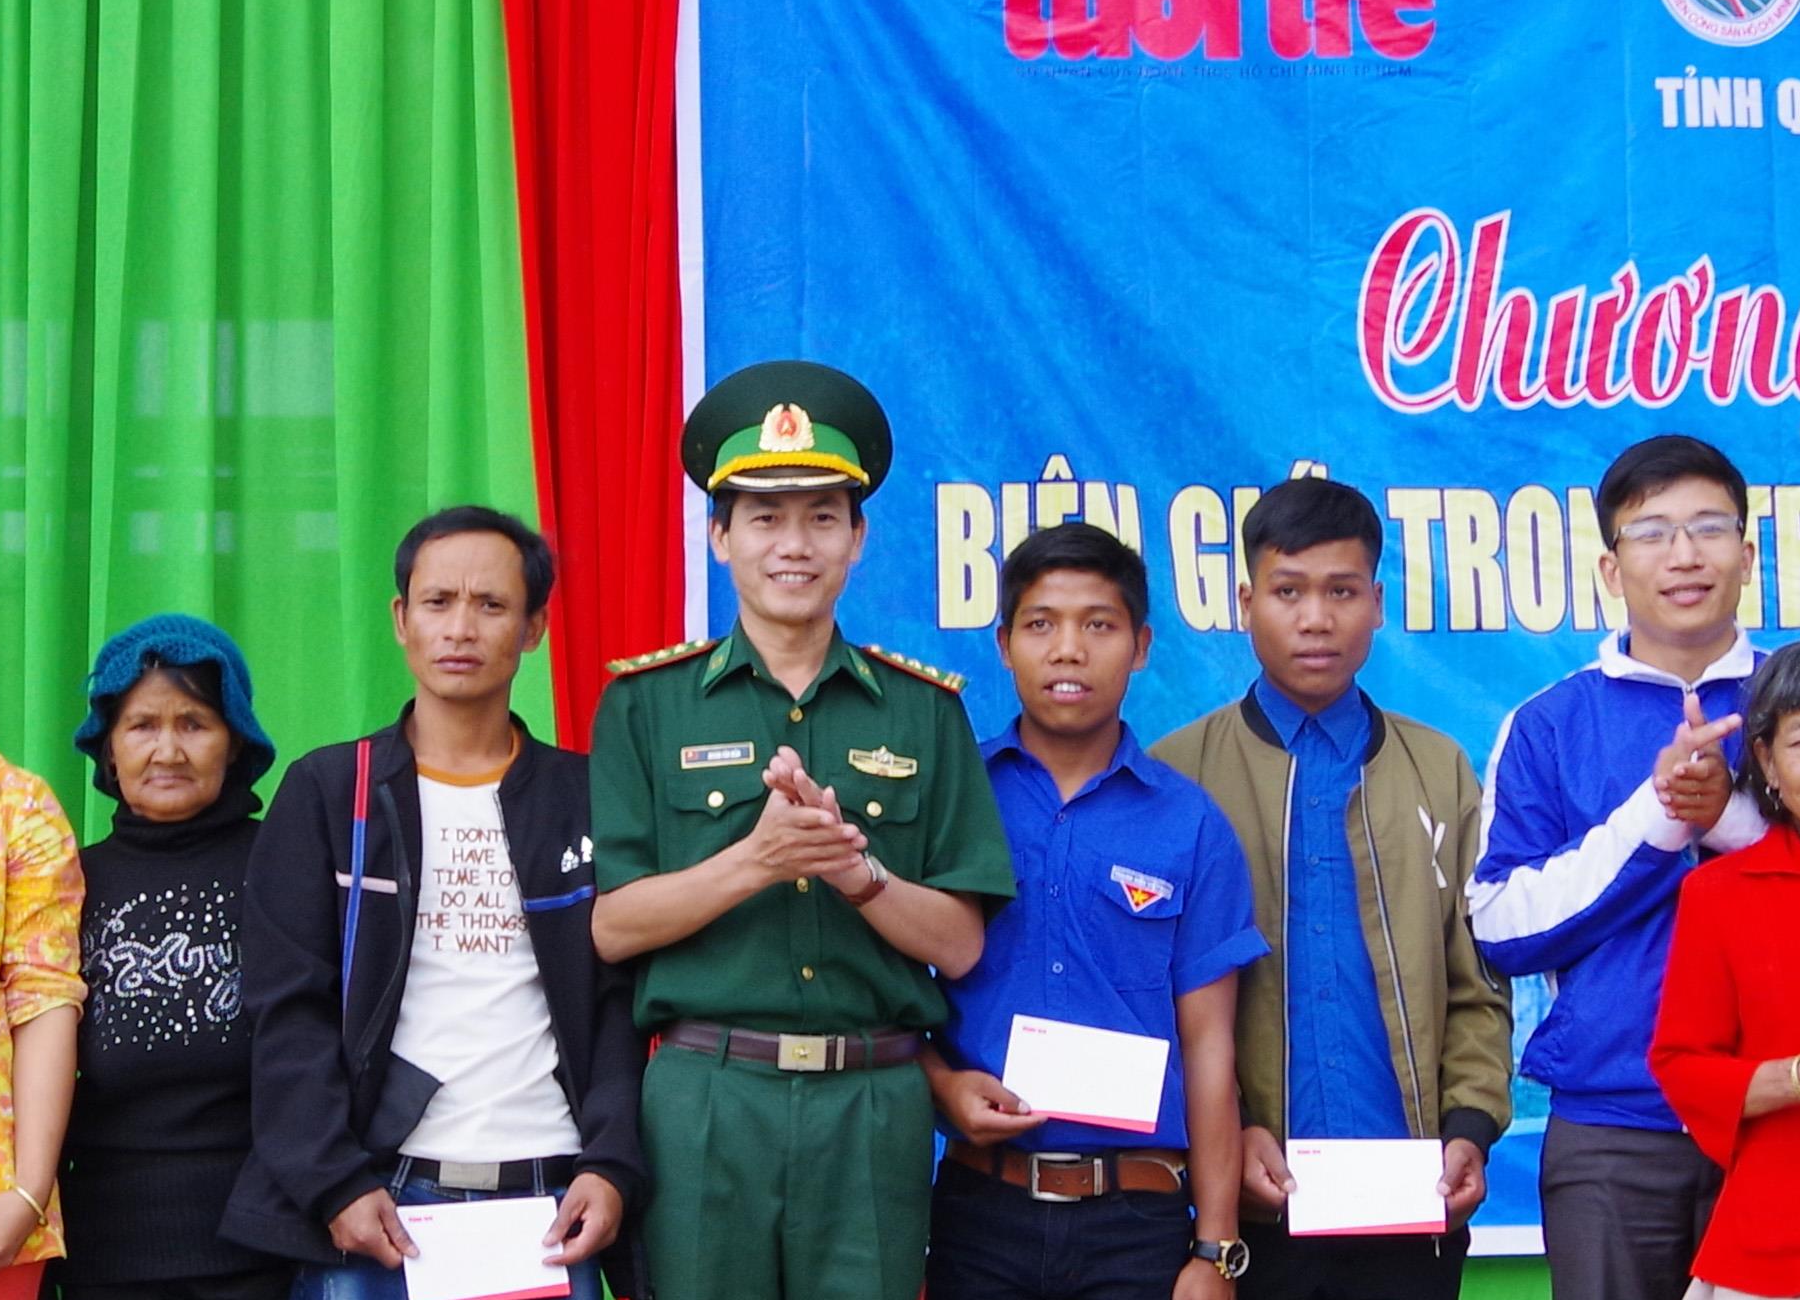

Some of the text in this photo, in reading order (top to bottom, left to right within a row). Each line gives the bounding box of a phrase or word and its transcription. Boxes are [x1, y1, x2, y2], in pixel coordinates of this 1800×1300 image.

[1655, 66, 1764, 129] TỈNH
[1388, 487, 1632, 633] TRON
[440, 828, 449, 842] I
[452, 847, 495, 865] HAVE
[432, 867, 514, 887] TIME TO
[441, 890, 506, 909] DO ALL
[418, 911, 528, 932] THE THINGS
[432, 933, 515, 954] I WANT
